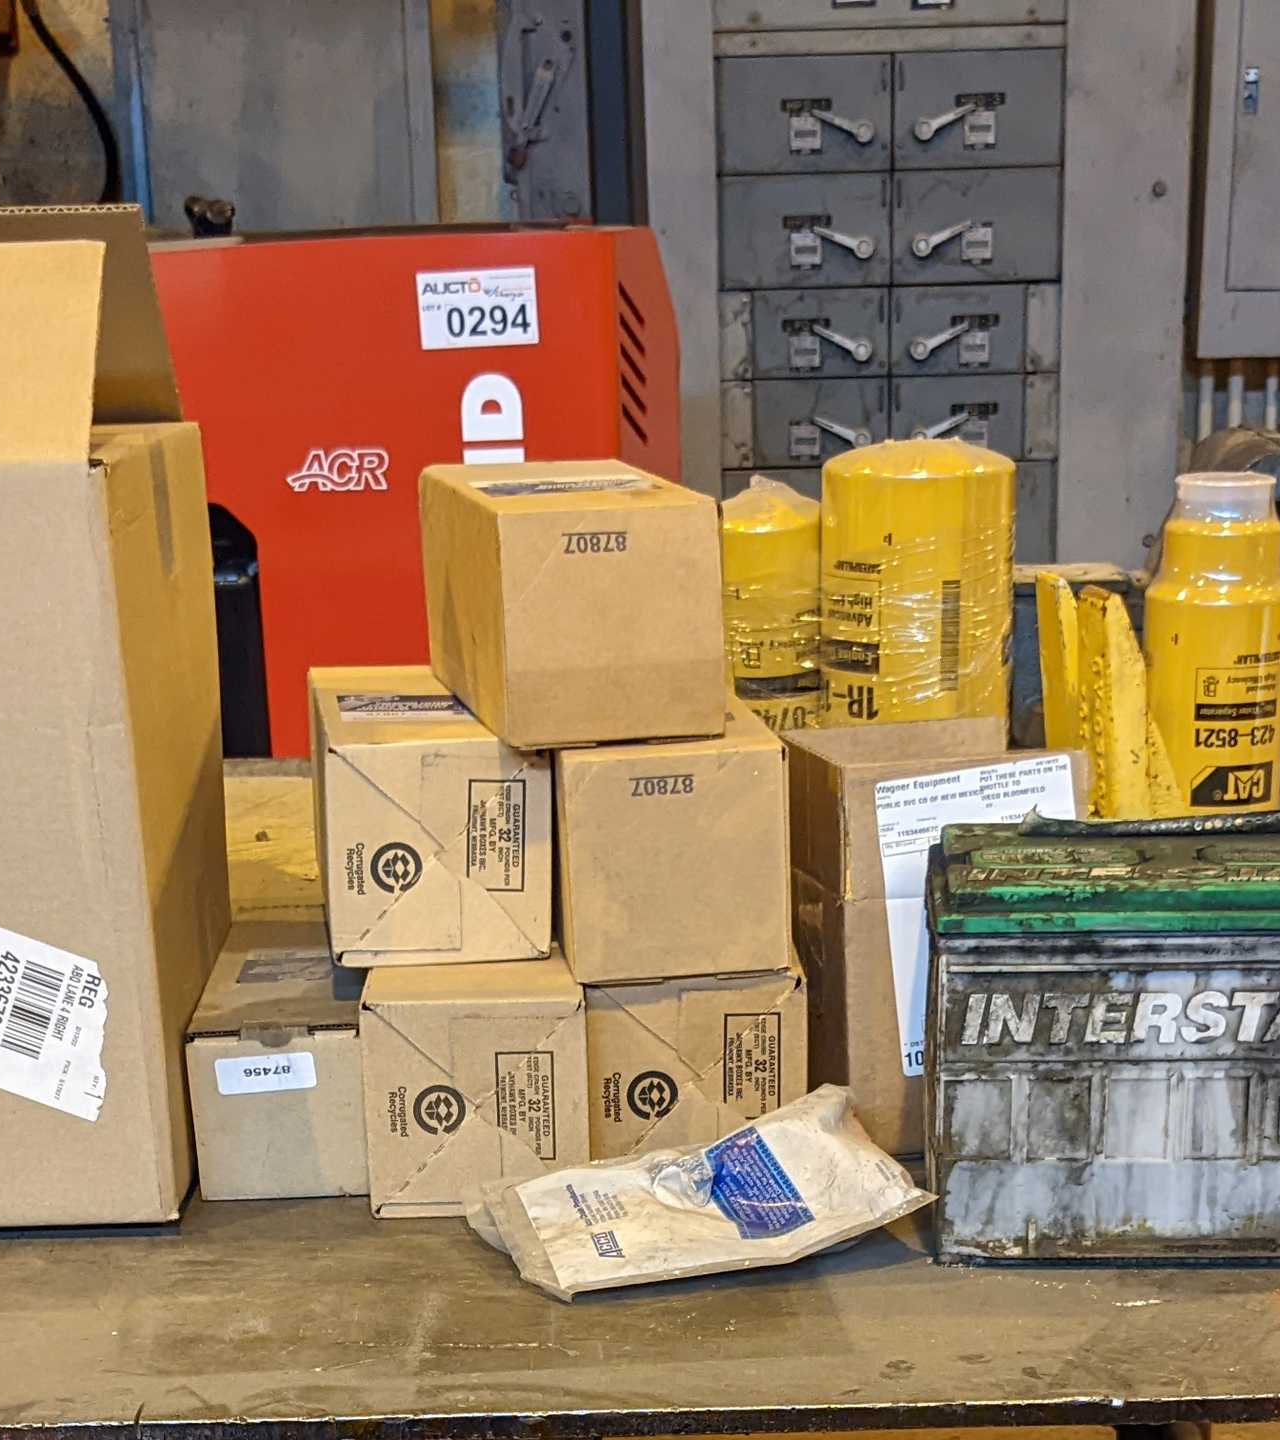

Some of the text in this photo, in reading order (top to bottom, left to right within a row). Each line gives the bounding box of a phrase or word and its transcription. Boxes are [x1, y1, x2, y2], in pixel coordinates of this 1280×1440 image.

[447, 303, 531, 337] 0294
[287, 446, 389, 492] ACR
[563, 534, 626, 554] 87807
[1195, 724, 1276, 749] 423-8521
[631, 776, 694, 796] 87807
[876, 775, 960, 794] Wagner Equipment
[979, 775, 993, 783] PUT
[1223, 769, 1265, 801] CAT
[877, 799, 901, 810] PUBLIC
[940, 793, 957, 801] NEW
[958, 788, 984, 798] MEXICO
[489, 841, 497, 853] BY
[498, 828, 511, 842] 32
[512, 803, 521, 868] GUARANTEED
[344, 848, 355, 890] Recycles
[356, 842, 366, 896] Corrugated
[69, 964, 85, 983] ABQ
[62, 981, 78, 1007] LANE
[78, 973, 101, 1009] REG
[61, 1006, 72, 1015] 4
[51, 1014, 69, 1041] RIGHT
[243, 1065, 291, 1078] 87456
[745, 1071, 753, 1083] BY
[754, 1059, 767, 1073] 32
[768, 1035, 776, 1097] GUARANTEED
[528, 1098, 541, 1112] 32
[541, 1075, 551, 1137] GUARANTEED
[604, 1078, 612, 1118] Recycles
[612, 1072, 622, 1122] Corrugated
[388, 1091, 399, 1133] Recycles
[397, 1086, 409, 1138] Corrugated
[518, 1111, 526, 1123] BY
